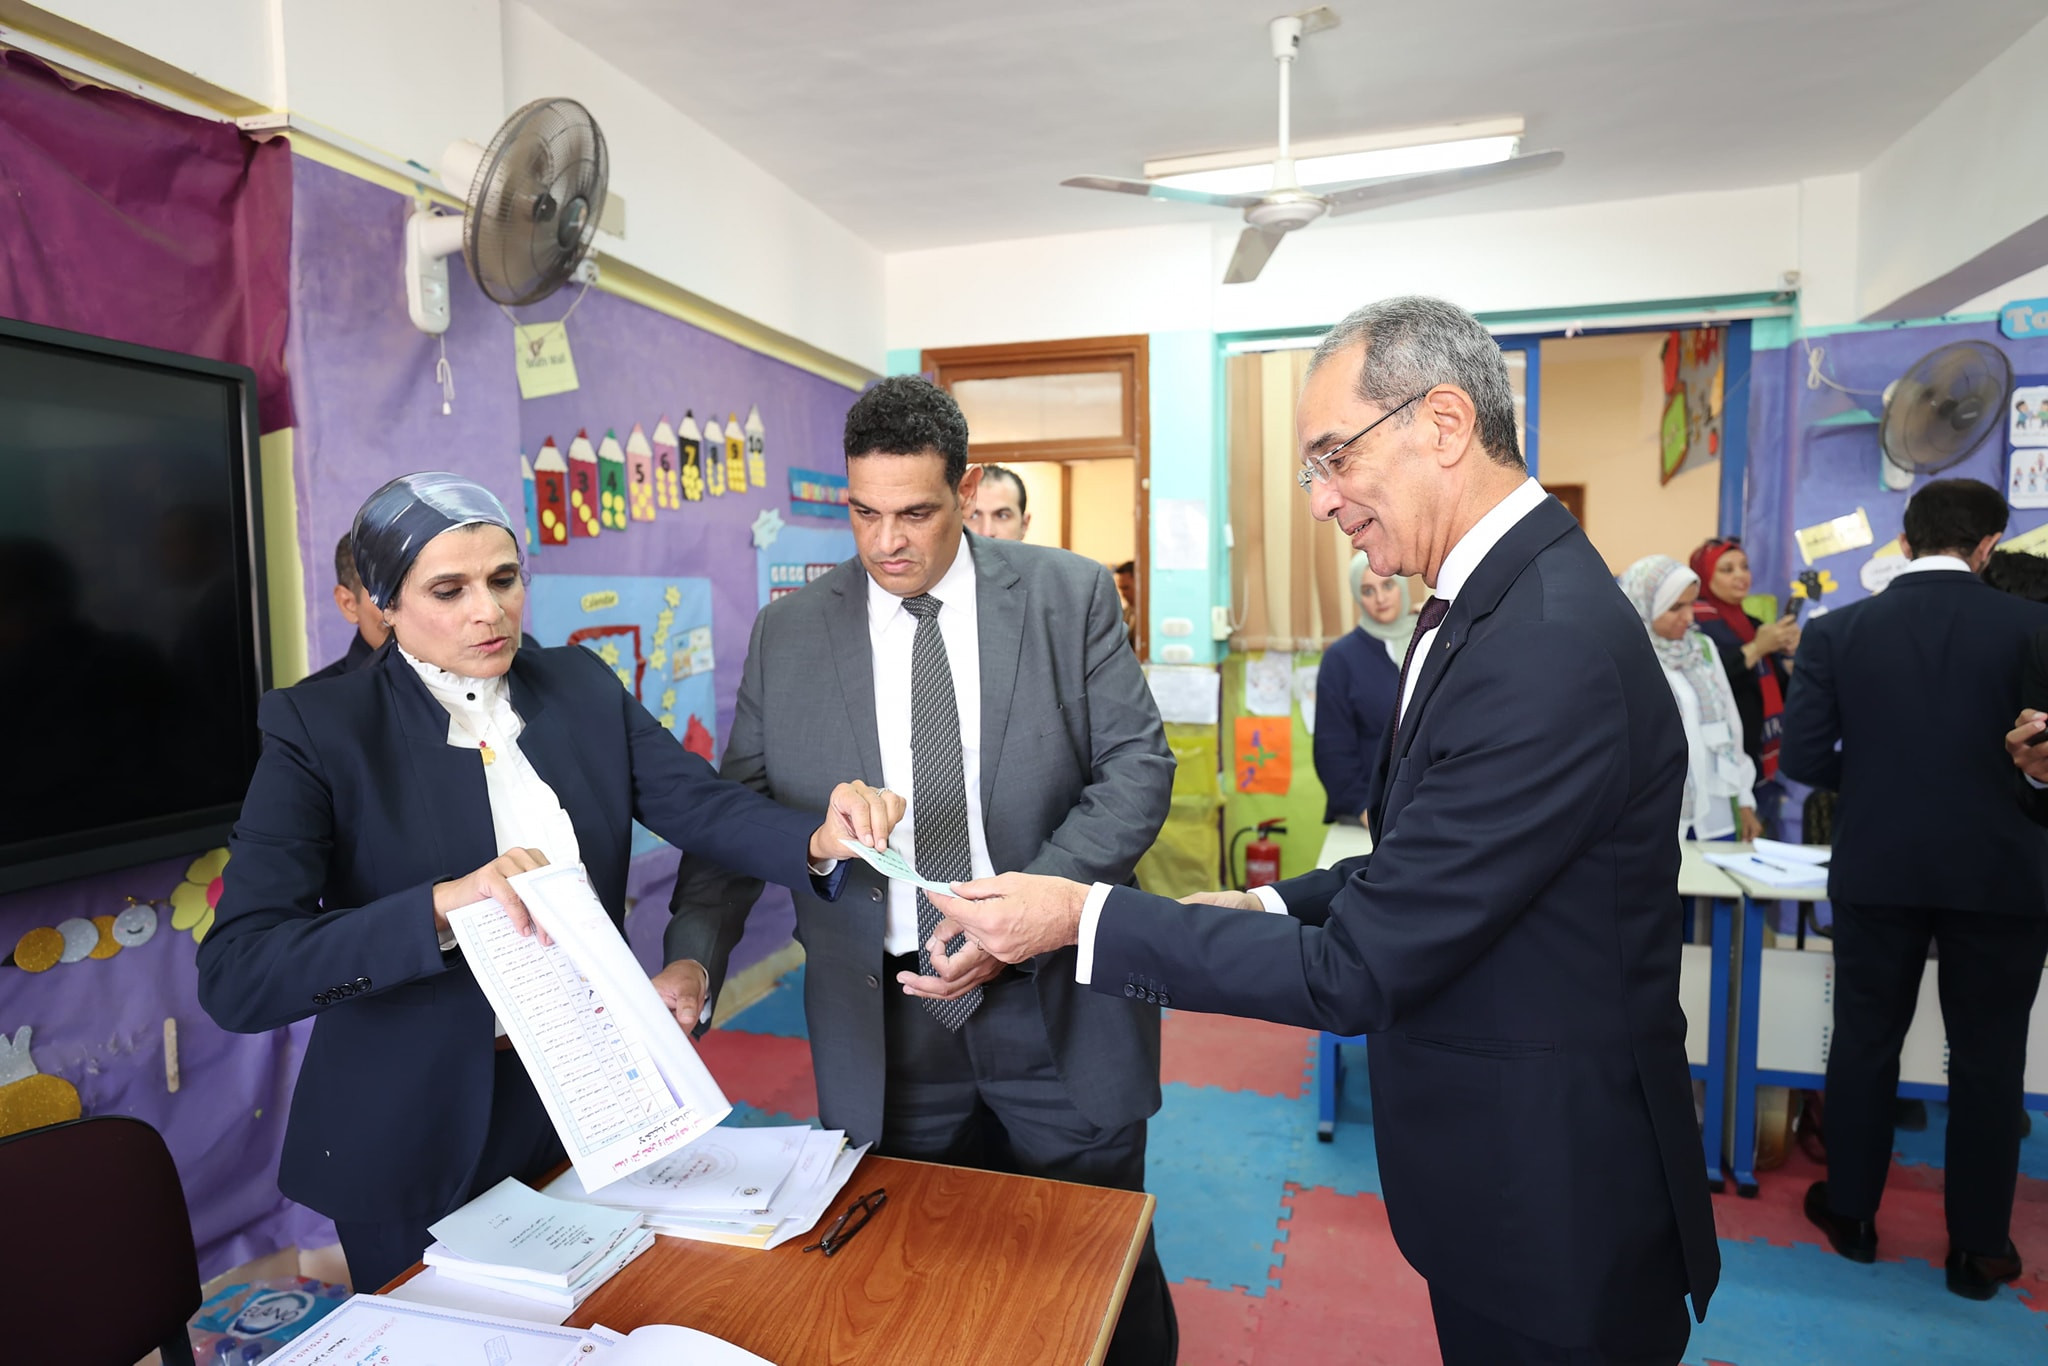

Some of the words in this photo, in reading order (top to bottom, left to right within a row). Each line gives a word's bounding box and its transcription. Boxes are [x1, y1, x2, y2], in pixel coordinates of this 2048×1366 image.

[546, 479, 559, 503] 2
[578, 470, 589, 492] 3
[607, 470, 618, 492] 4
[635, 464, 645, 484] 5
[660, 453, 671, 472] 6
[684, 445, 696, 466] 7
[731, 443, 739, 460] 9
[749, 435, 763, 454] 10
